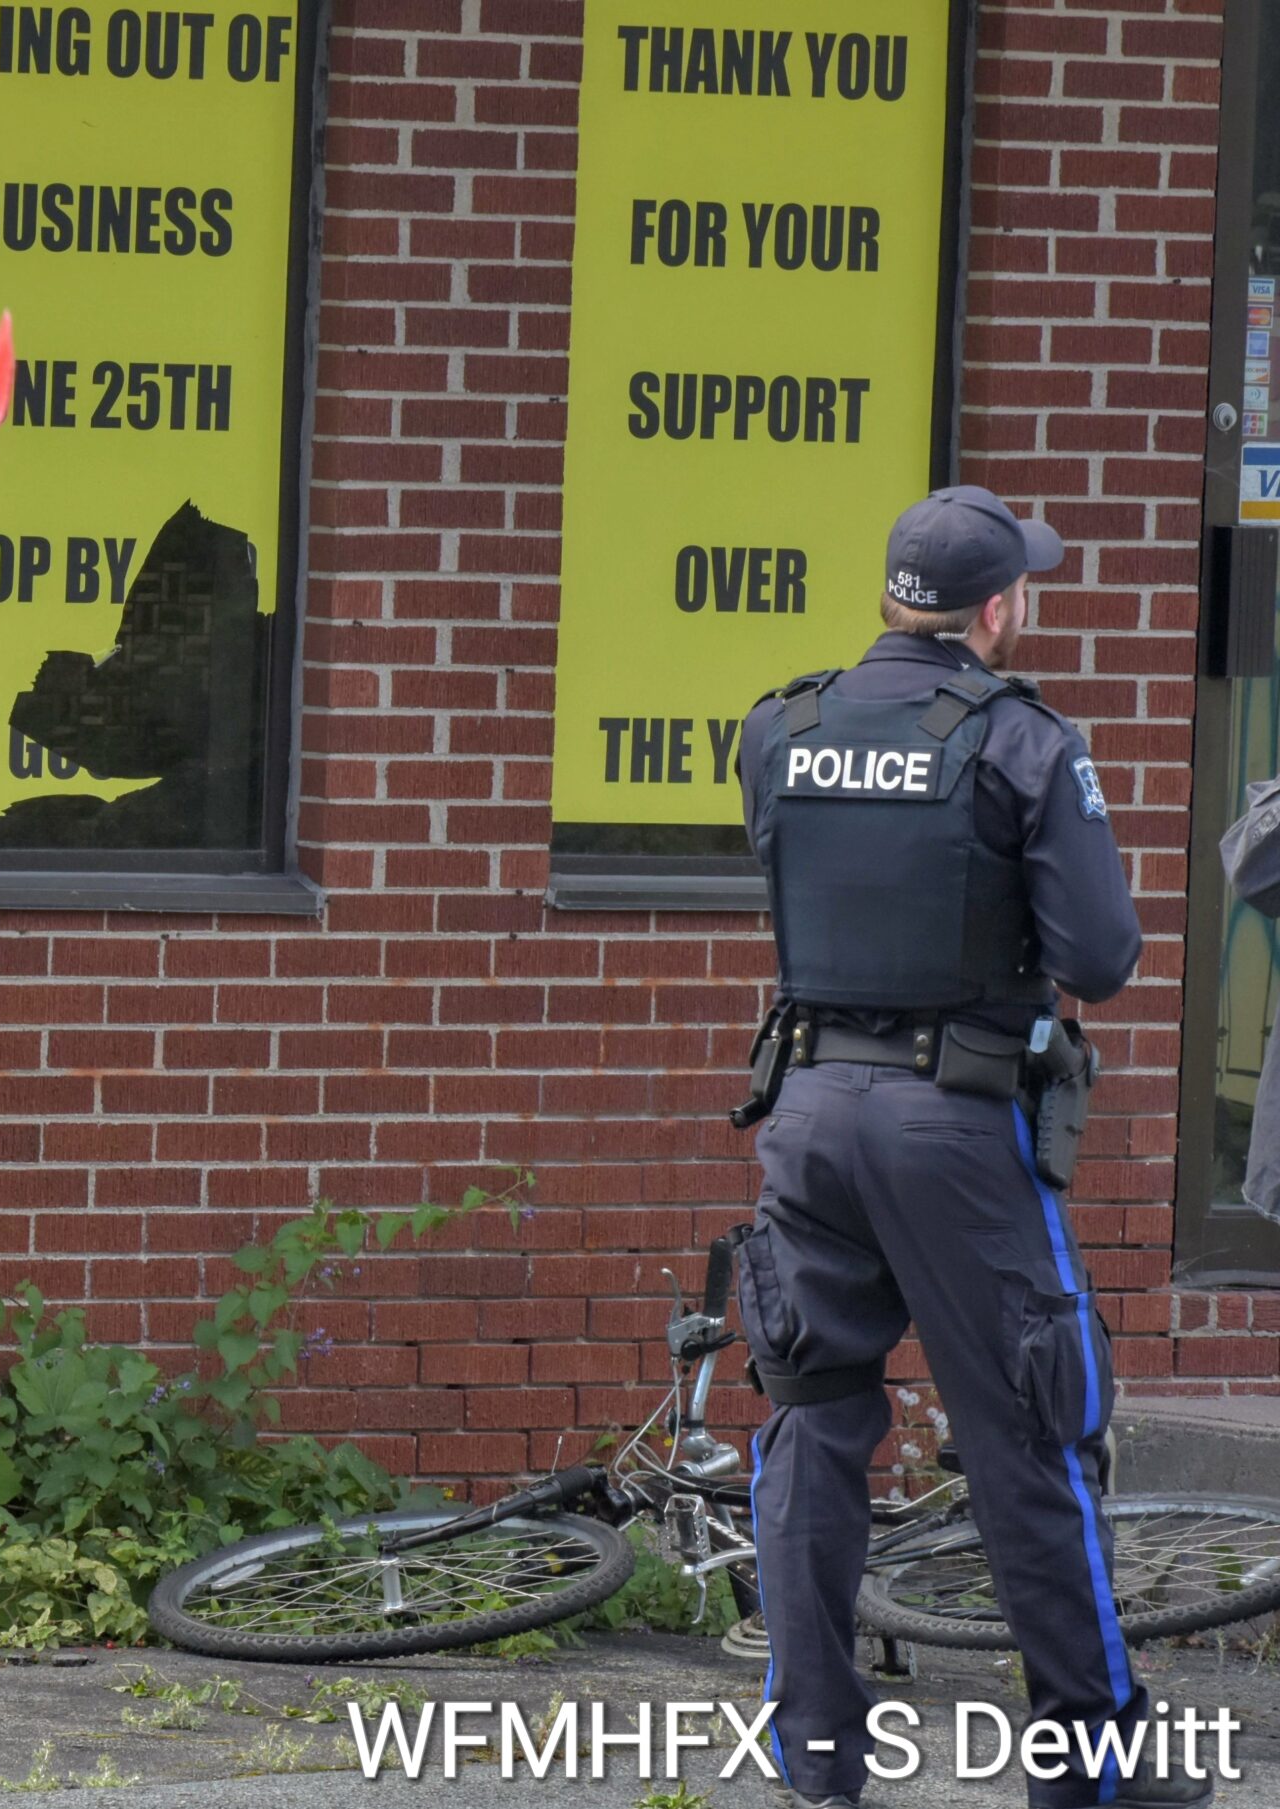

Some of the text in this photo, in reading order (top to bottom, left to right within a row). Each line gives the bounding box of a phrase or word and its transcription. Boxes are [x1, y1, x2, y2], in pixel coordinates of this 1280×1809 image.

[106, 9, 214, 80] OUT
[227, 13, 292, 83] OF
[618, 25, 908, 102] THANK YOU
[630, 199, 880, 272] FOR YOUR
[90, 361, 232, 431] 25TH
[628, 371, 871, 443] SUPPORT
[65, 536, 137, 604] BY
[675, 545, 808, 614] OVER
[888, 578, 938, 604] POLICE
[897, 570, 921, 590] 581
[598, 717, 746, 784] THE Y
[786, 749, 931, 792] POLICE
